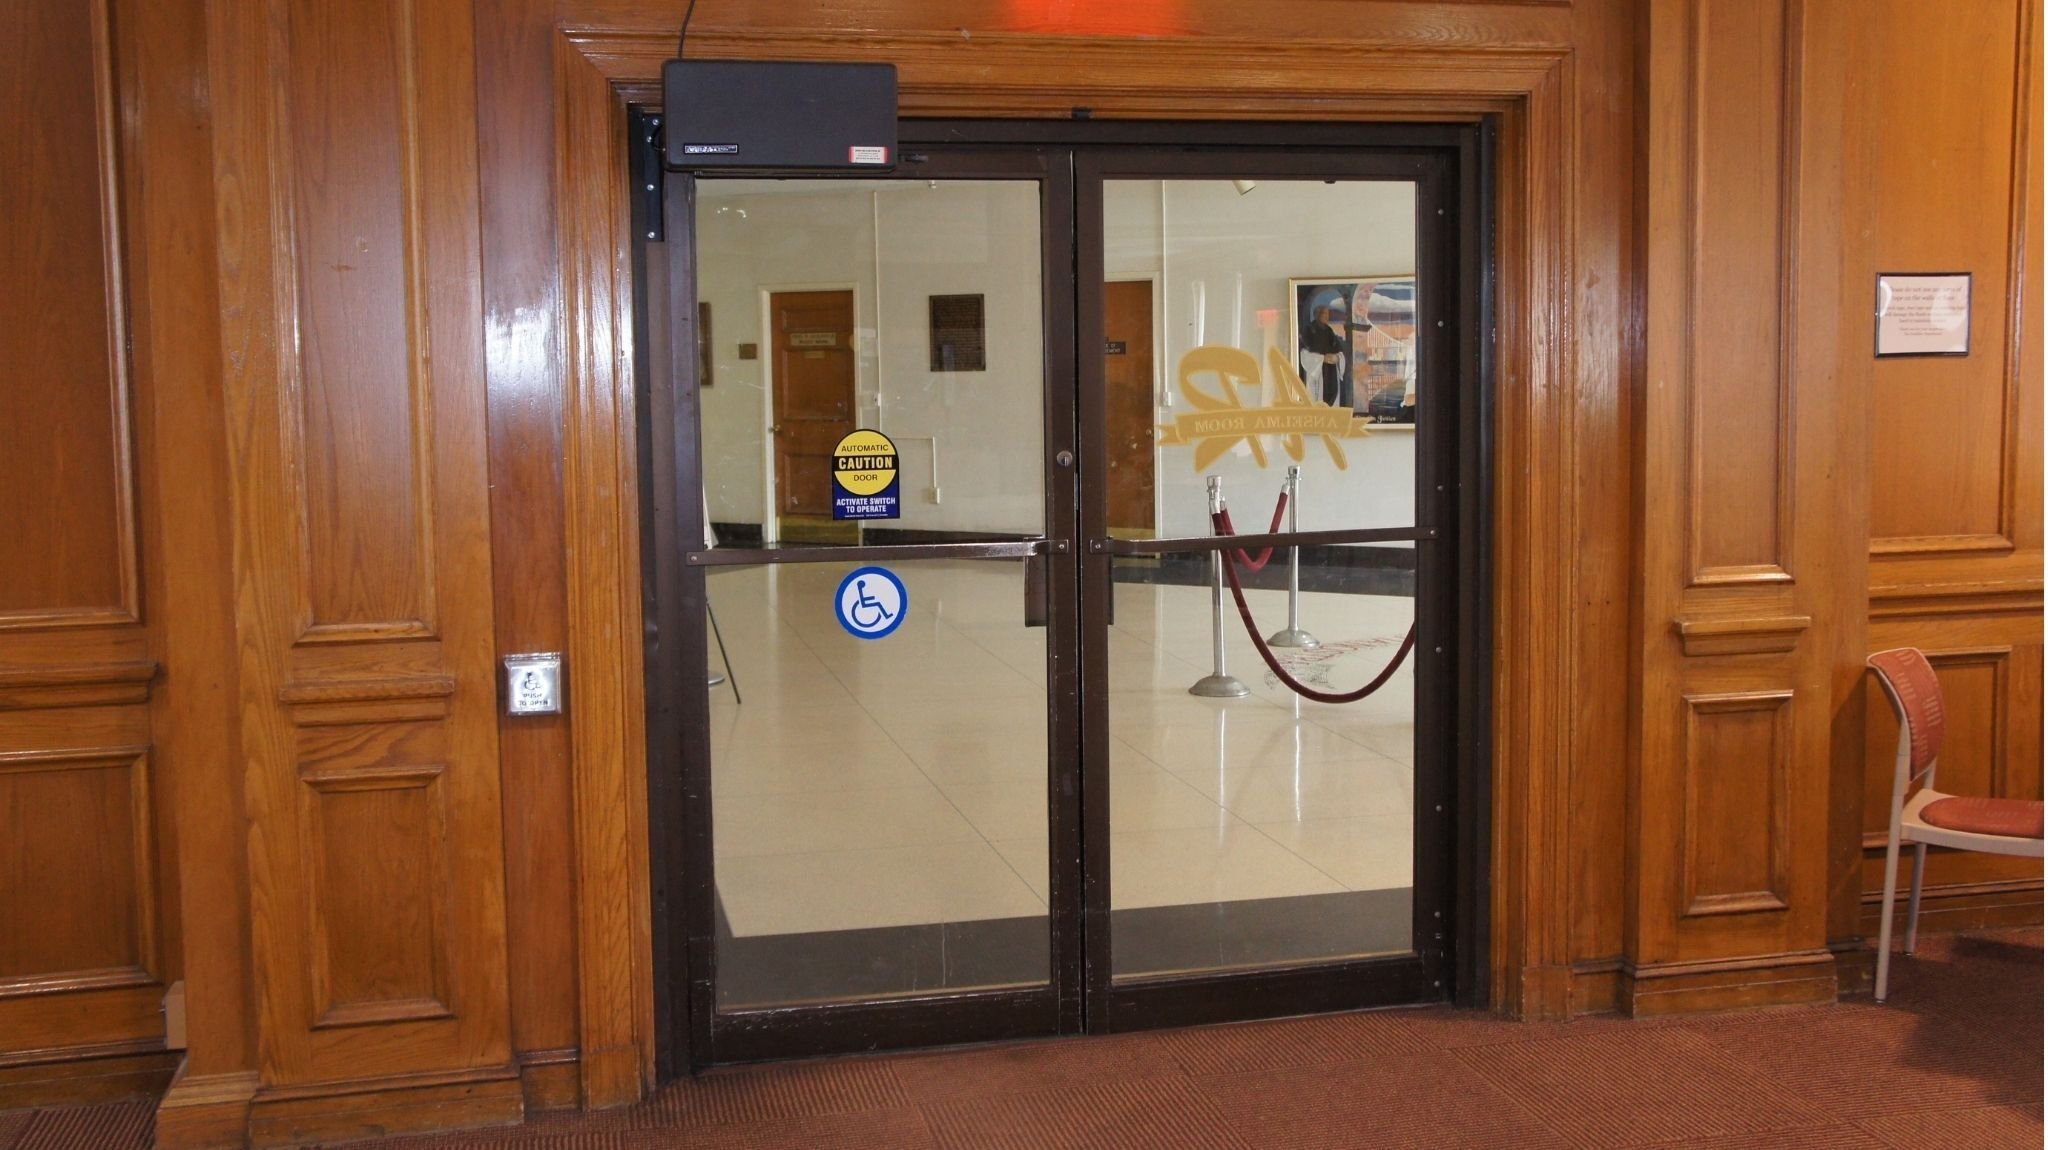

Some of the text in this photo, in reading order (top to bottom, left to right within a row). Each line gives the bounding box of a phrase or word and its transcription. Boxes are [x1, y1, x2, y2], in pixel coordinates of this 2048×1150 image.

[841, 444, 889, 452] AUTOMATIC
[838, 456, 893, 470] CAUTION
[836, 497, 896, 506] ACTIVATE SWITCH
[846, 505, 887, 513] TO OPERATE
